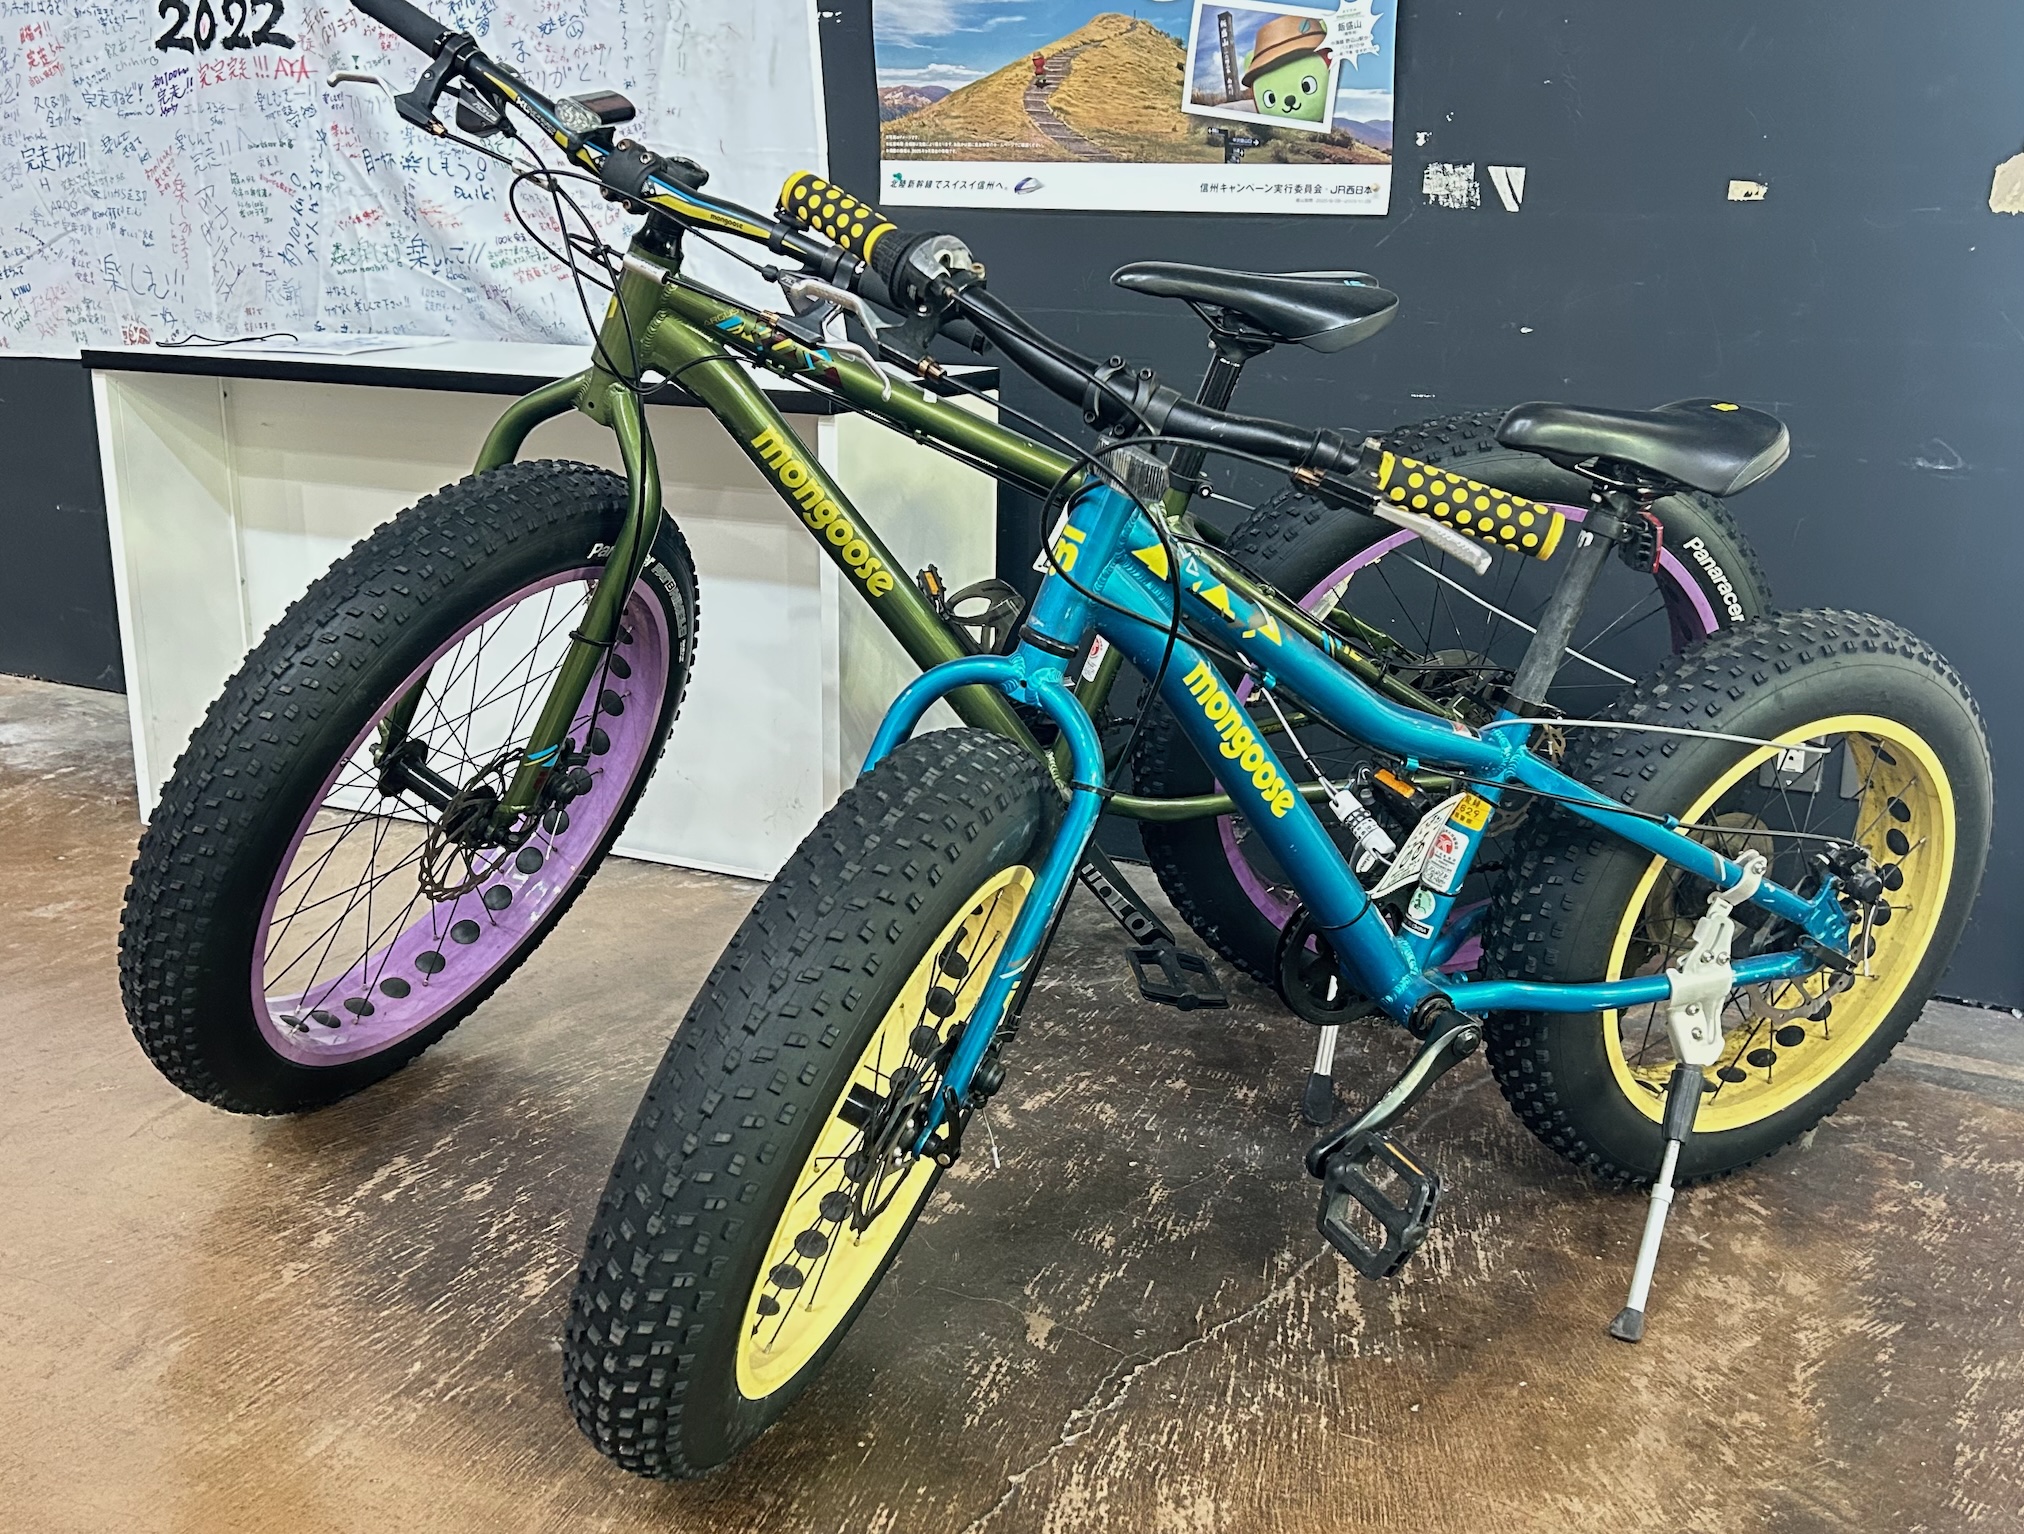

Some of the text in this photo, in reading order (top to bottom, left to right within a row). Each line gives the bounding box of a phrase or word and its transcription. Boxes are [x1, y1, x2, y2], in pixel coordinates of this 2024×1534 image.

[155, 0, 296, 54] 2022
[274, 55, 318, 83] AYA
[709, 213, 743, 230] mongoose
[702, 307, 741, 327] ARGUS
[751, 424, 894, 598] mongoose
[1682, 536, 1746, 623] Panaracer
[1182, 659, 1295, 818] mongoose
